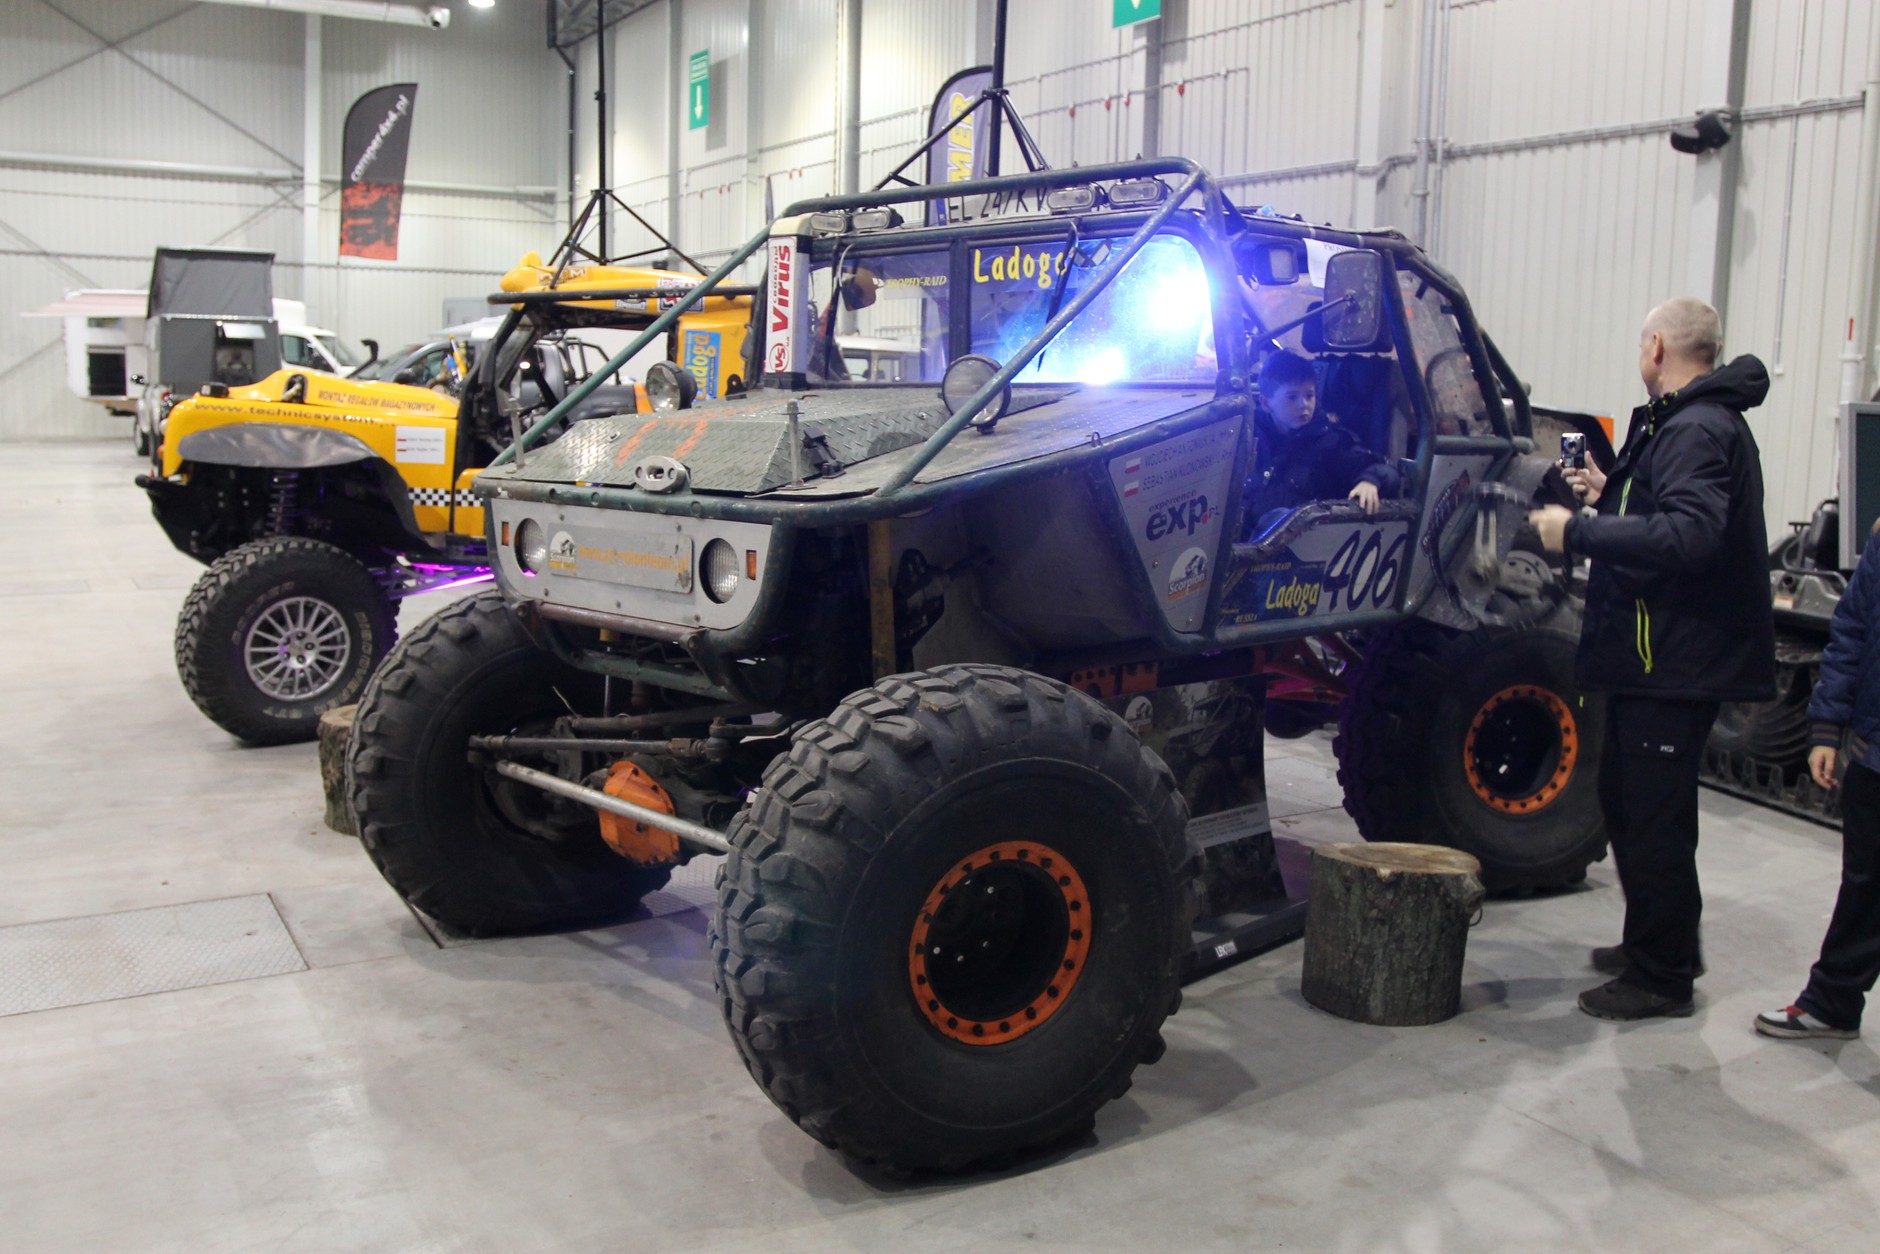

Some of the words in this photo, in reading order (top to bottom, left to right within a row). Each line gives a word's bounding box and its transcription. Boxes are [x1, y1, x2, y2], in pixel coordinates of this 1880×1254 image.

[350, 93, 410, 182] camper4x4.pl
[772, 245, 791, 333] Virus
[1148, 489, 1197, 513] experience
[1168, 573, 1206, 596] Scorpion
[1265, 575, 1320, 617] Ladoga
[1323, 529, 1408, 613] 406
